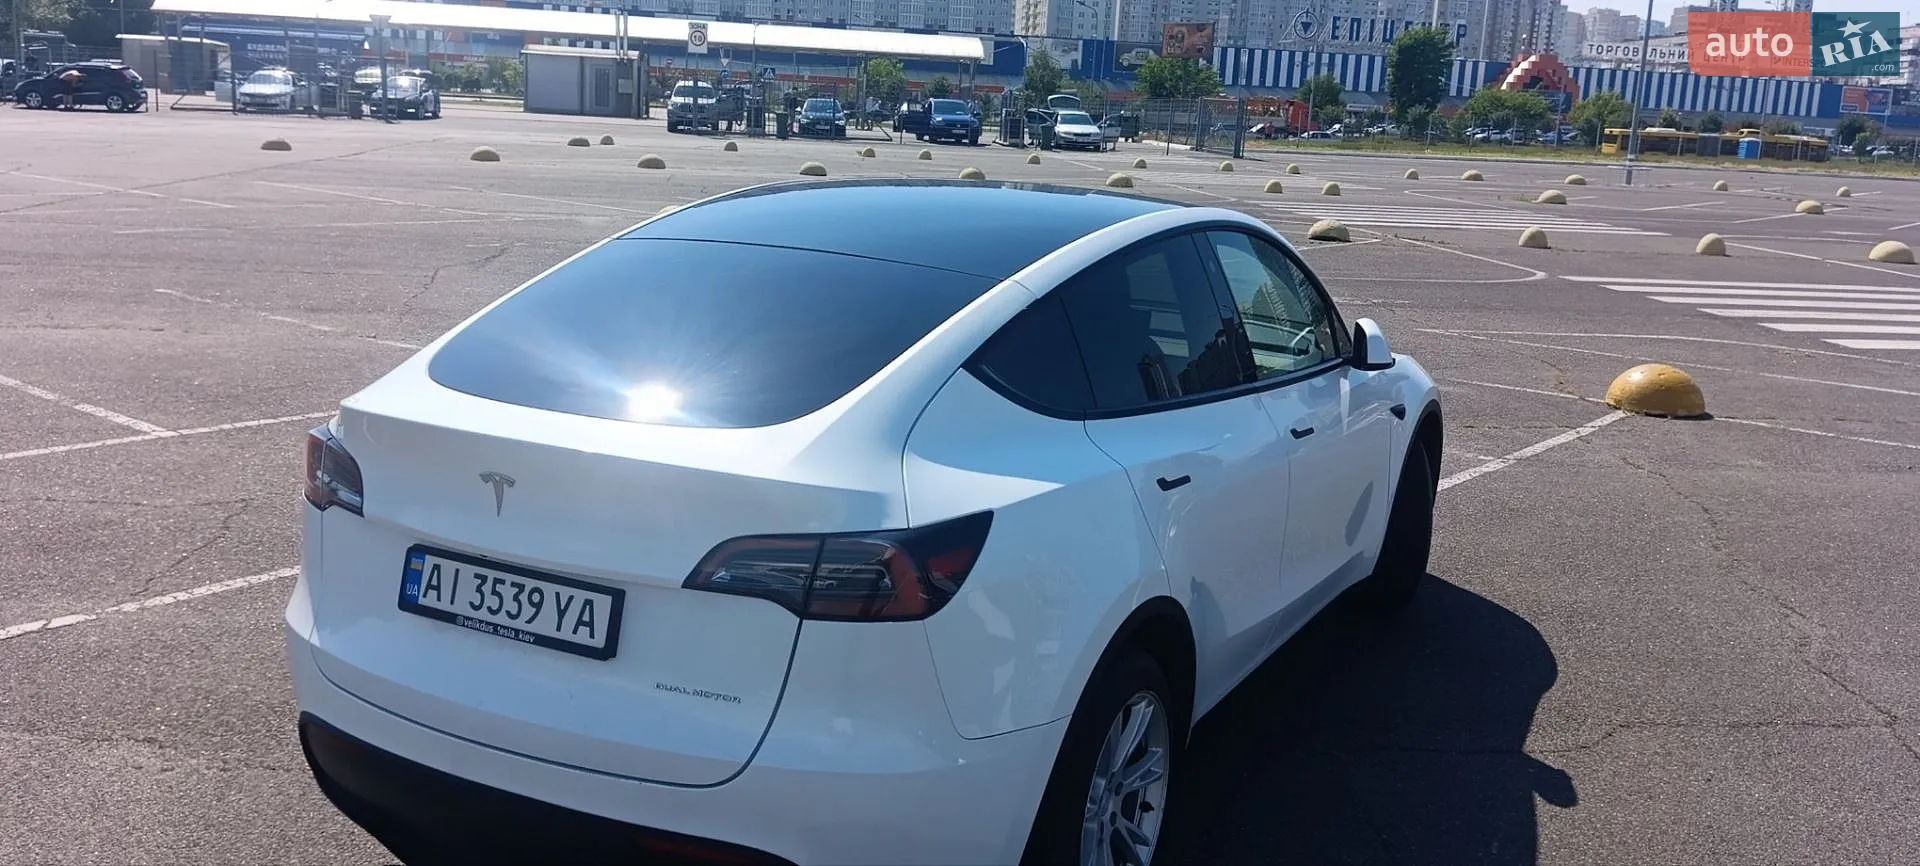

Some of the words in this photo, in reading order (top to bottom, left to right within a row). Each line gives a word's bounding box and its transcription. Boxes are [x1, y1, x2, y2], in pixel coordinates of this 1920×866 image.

[693, 34, 703, 42] 10
[1331, 16, 1467, 47] ЕПІЦР
[405, 583, 419, 597] UA
[422, 563, 460, 606] AI
[468, 572, 545, 625] 3539
[554, 591, 596, 640] YA
[655, 682, 690, 695] DUAL
[692, 688, 742, 704] MOTOR
